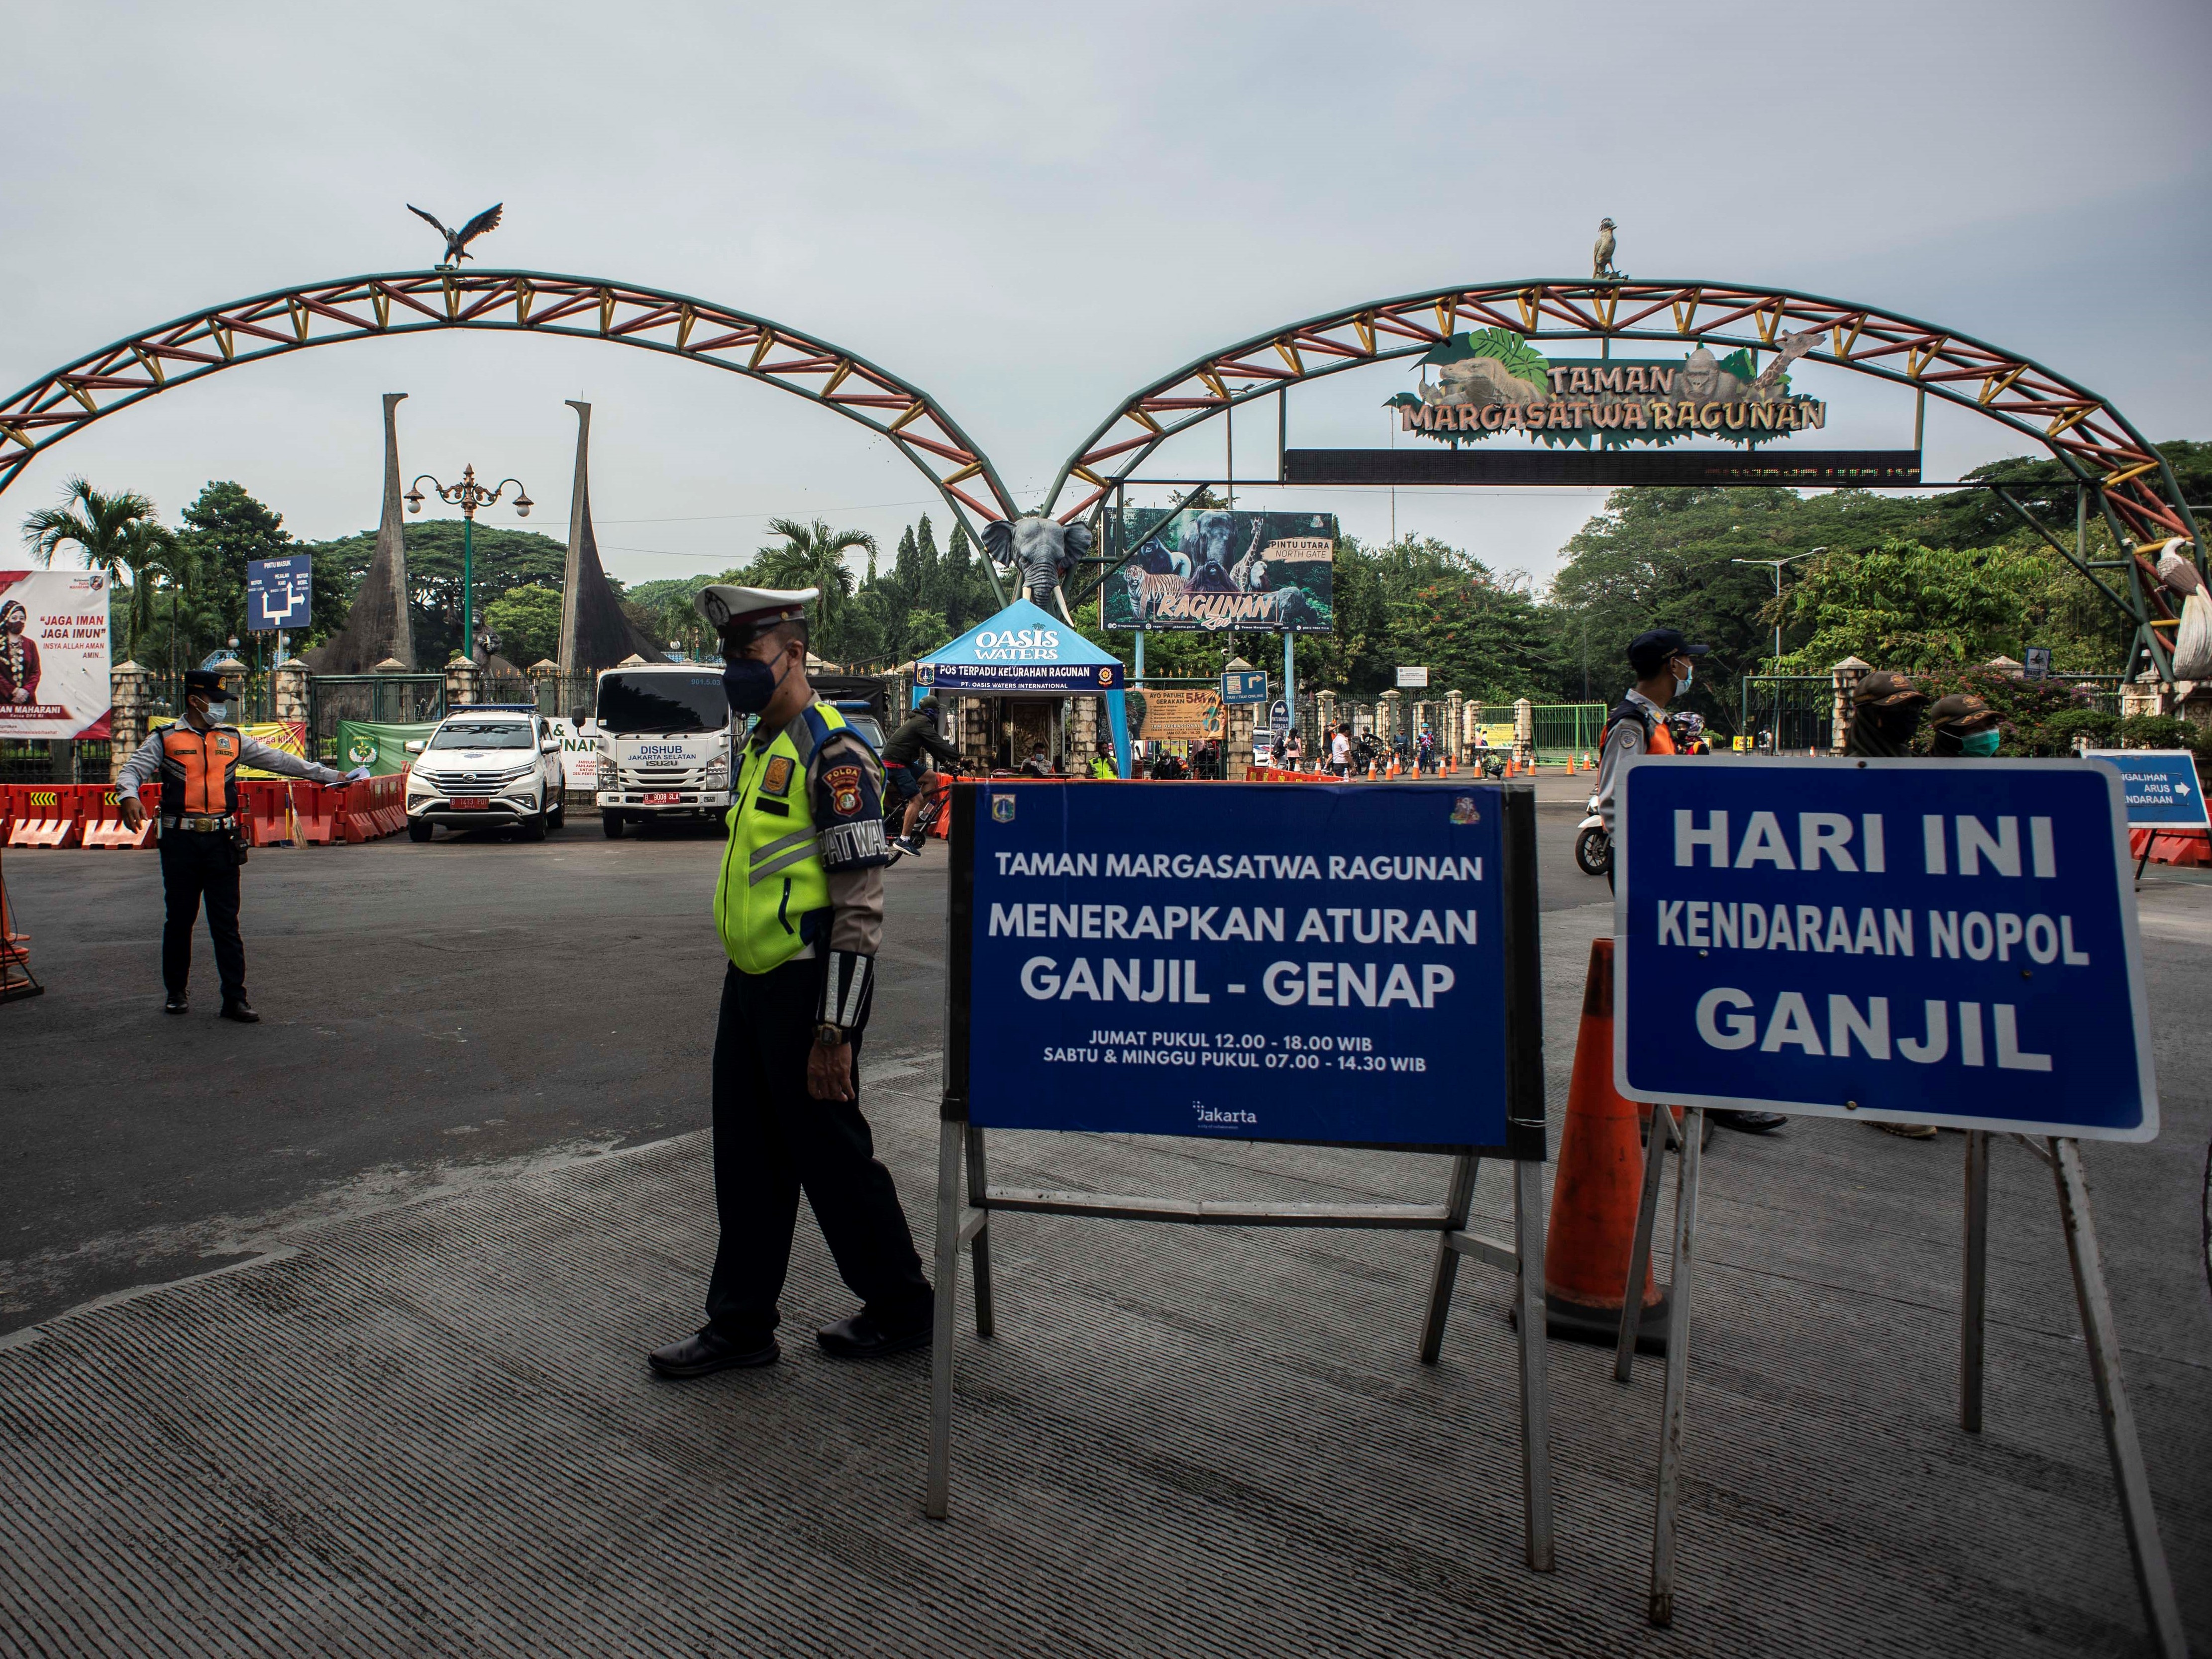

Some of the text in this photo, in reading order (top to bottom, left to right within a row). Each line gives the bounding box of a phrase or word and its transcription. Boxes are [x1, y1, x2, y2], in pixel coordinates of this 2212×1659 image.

[1547, 366, 1675, 395] TAMAN
[1399, 401, 1826, 431] MARGASATWA RAGUNAN
[1157, 594, 1273, 619] RAGUNAN
[76, 616, 104, 625] IMAN
[1201, 614, 1232, 630] Zoo
[41, 629, 69, 638] JAGA
[975, 629, 1060, 648] OASIS
[974, 648, 1058, 660] WATERS
[940, 665, 1090, 677] POS TERPADU KELURAHAN RAGUNAN
[1186, 692, 1206, 704] 5M
[554, 724, 565, 736] &
[827, 768, 858, 780] POLDA
[1674, 809, 2057, 878] HARI INI
[995, 852, 1483, 881] TAMAN MARGASATWA RAGUNAN
[988, 903, 1477, 944] MENERAPKAN ATURAN
[1657, 900, 2090, 966] KENDARAAN NOPOL
[1020, 956, 1455, 1009] GANJIL - GENAP
[1089, 1030, 1147, 1046] JUMAT
[1152, 1032, 1210, 1048] PUKUL
[1215, 1034, 1265, 1049] 12.00
[1283, 1035, 1334, 1051] 18.00
[1337, 1037, 1372, 1051] WIB
[1695, 987, 2053, 1072] GANJIL
[1043, 1047, 1098, 1063] SABTU
[1104, 1049, 1118, 1063] &
[1122, 1049, 1196, 1066] MINGGU
[1201, 1052, 1260, 1067] PUKUL
[1264, 1053, 1320, 1069] 07.00
[1338, 1056, 1386, 1071] 14.30
[1390, 1057, 1426, 1072] WIB
